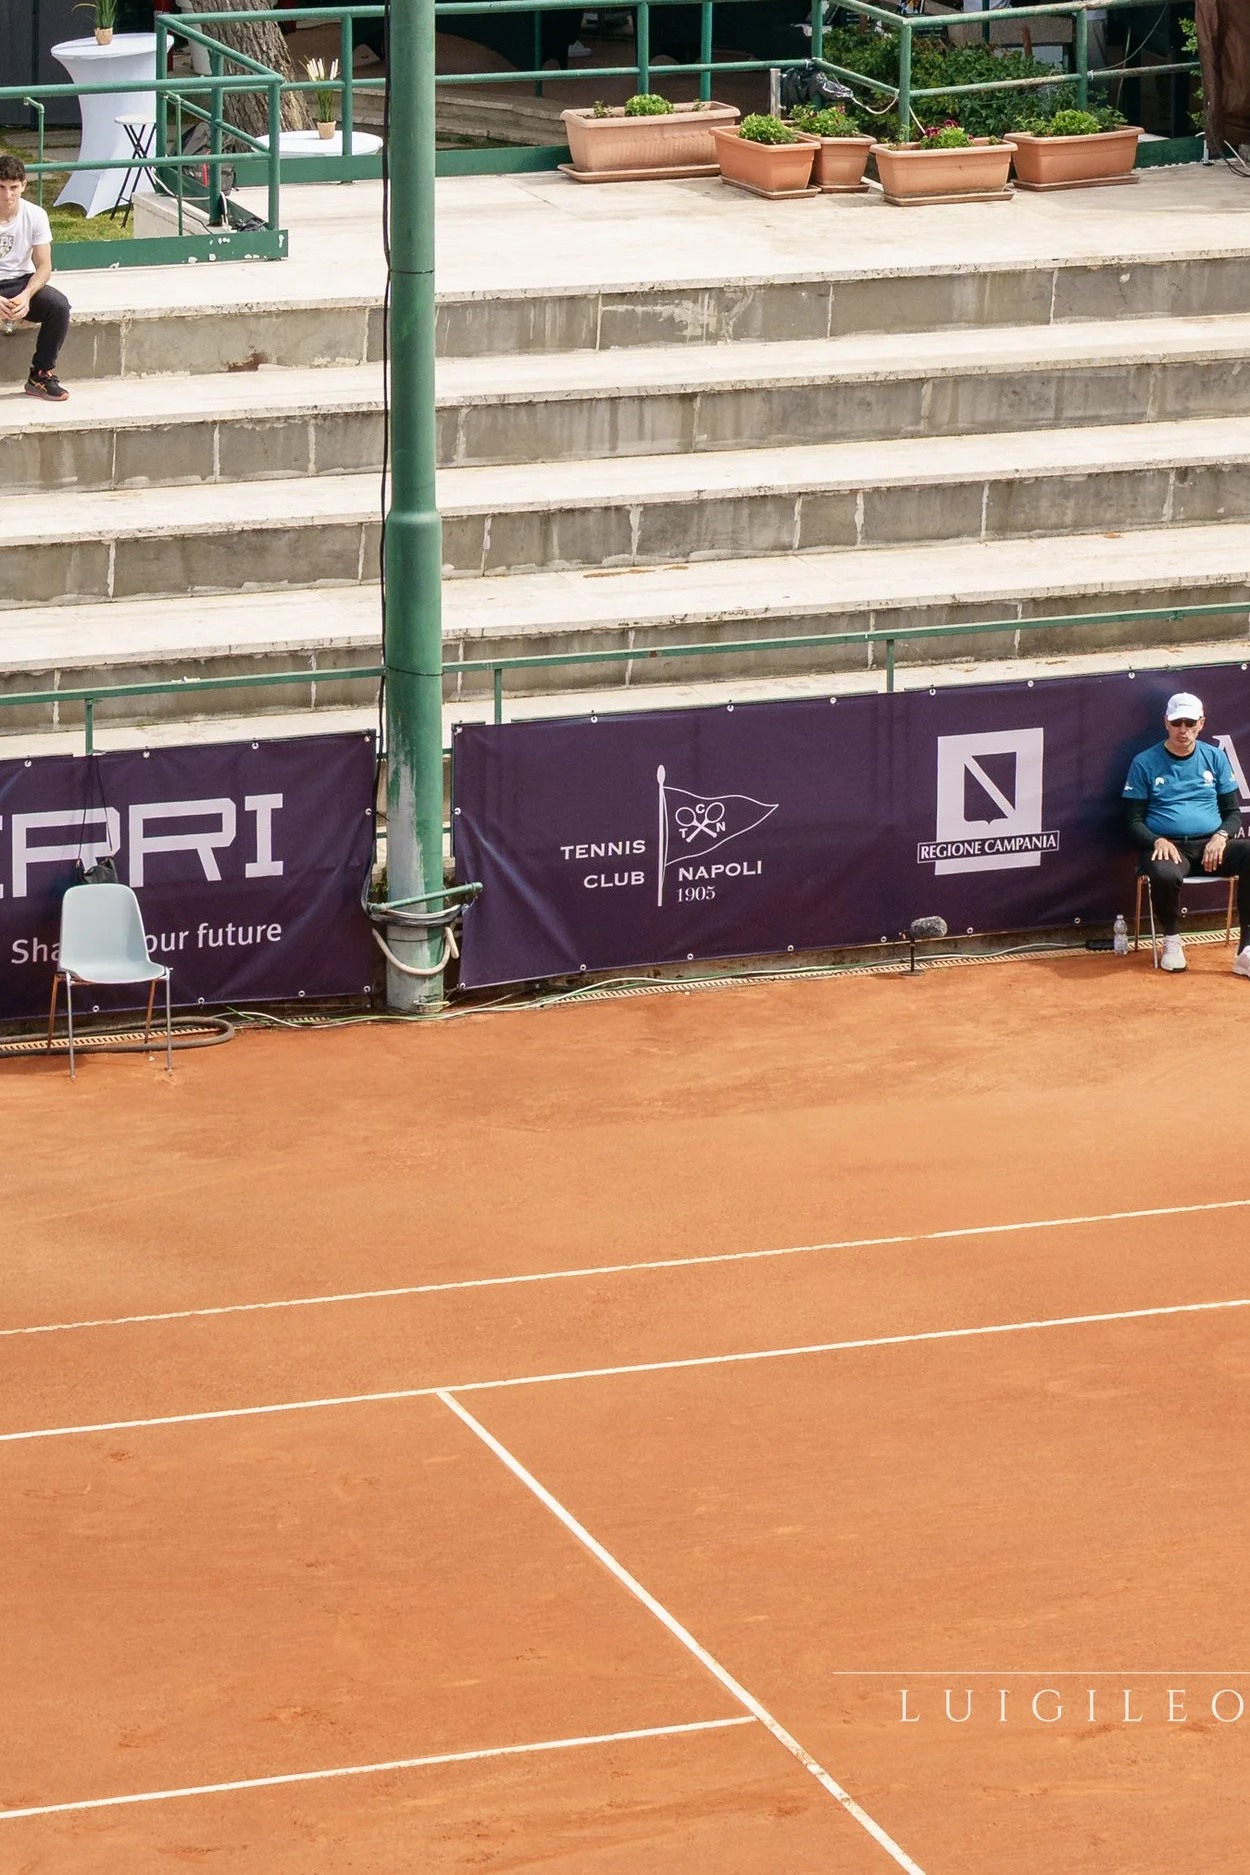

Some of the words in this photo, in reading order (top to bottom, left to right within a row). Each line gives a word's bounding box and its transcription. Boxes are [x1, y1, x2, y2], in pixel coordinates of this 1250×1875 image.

[0, 793, 283, 899] RRI
[560, 840, 646, 860] TENNIS
[920, 841, 982, 860] REGIONE
[984, 834, 1057, 854] CAMPANIA
[583, 871, 645, 889] CLUB
[678, 860, 762, 882] NAPOLI
[676, 885, 716, 903] 1905
[145, 930, 189, 953] our
[197, 922, 282, 948] future
